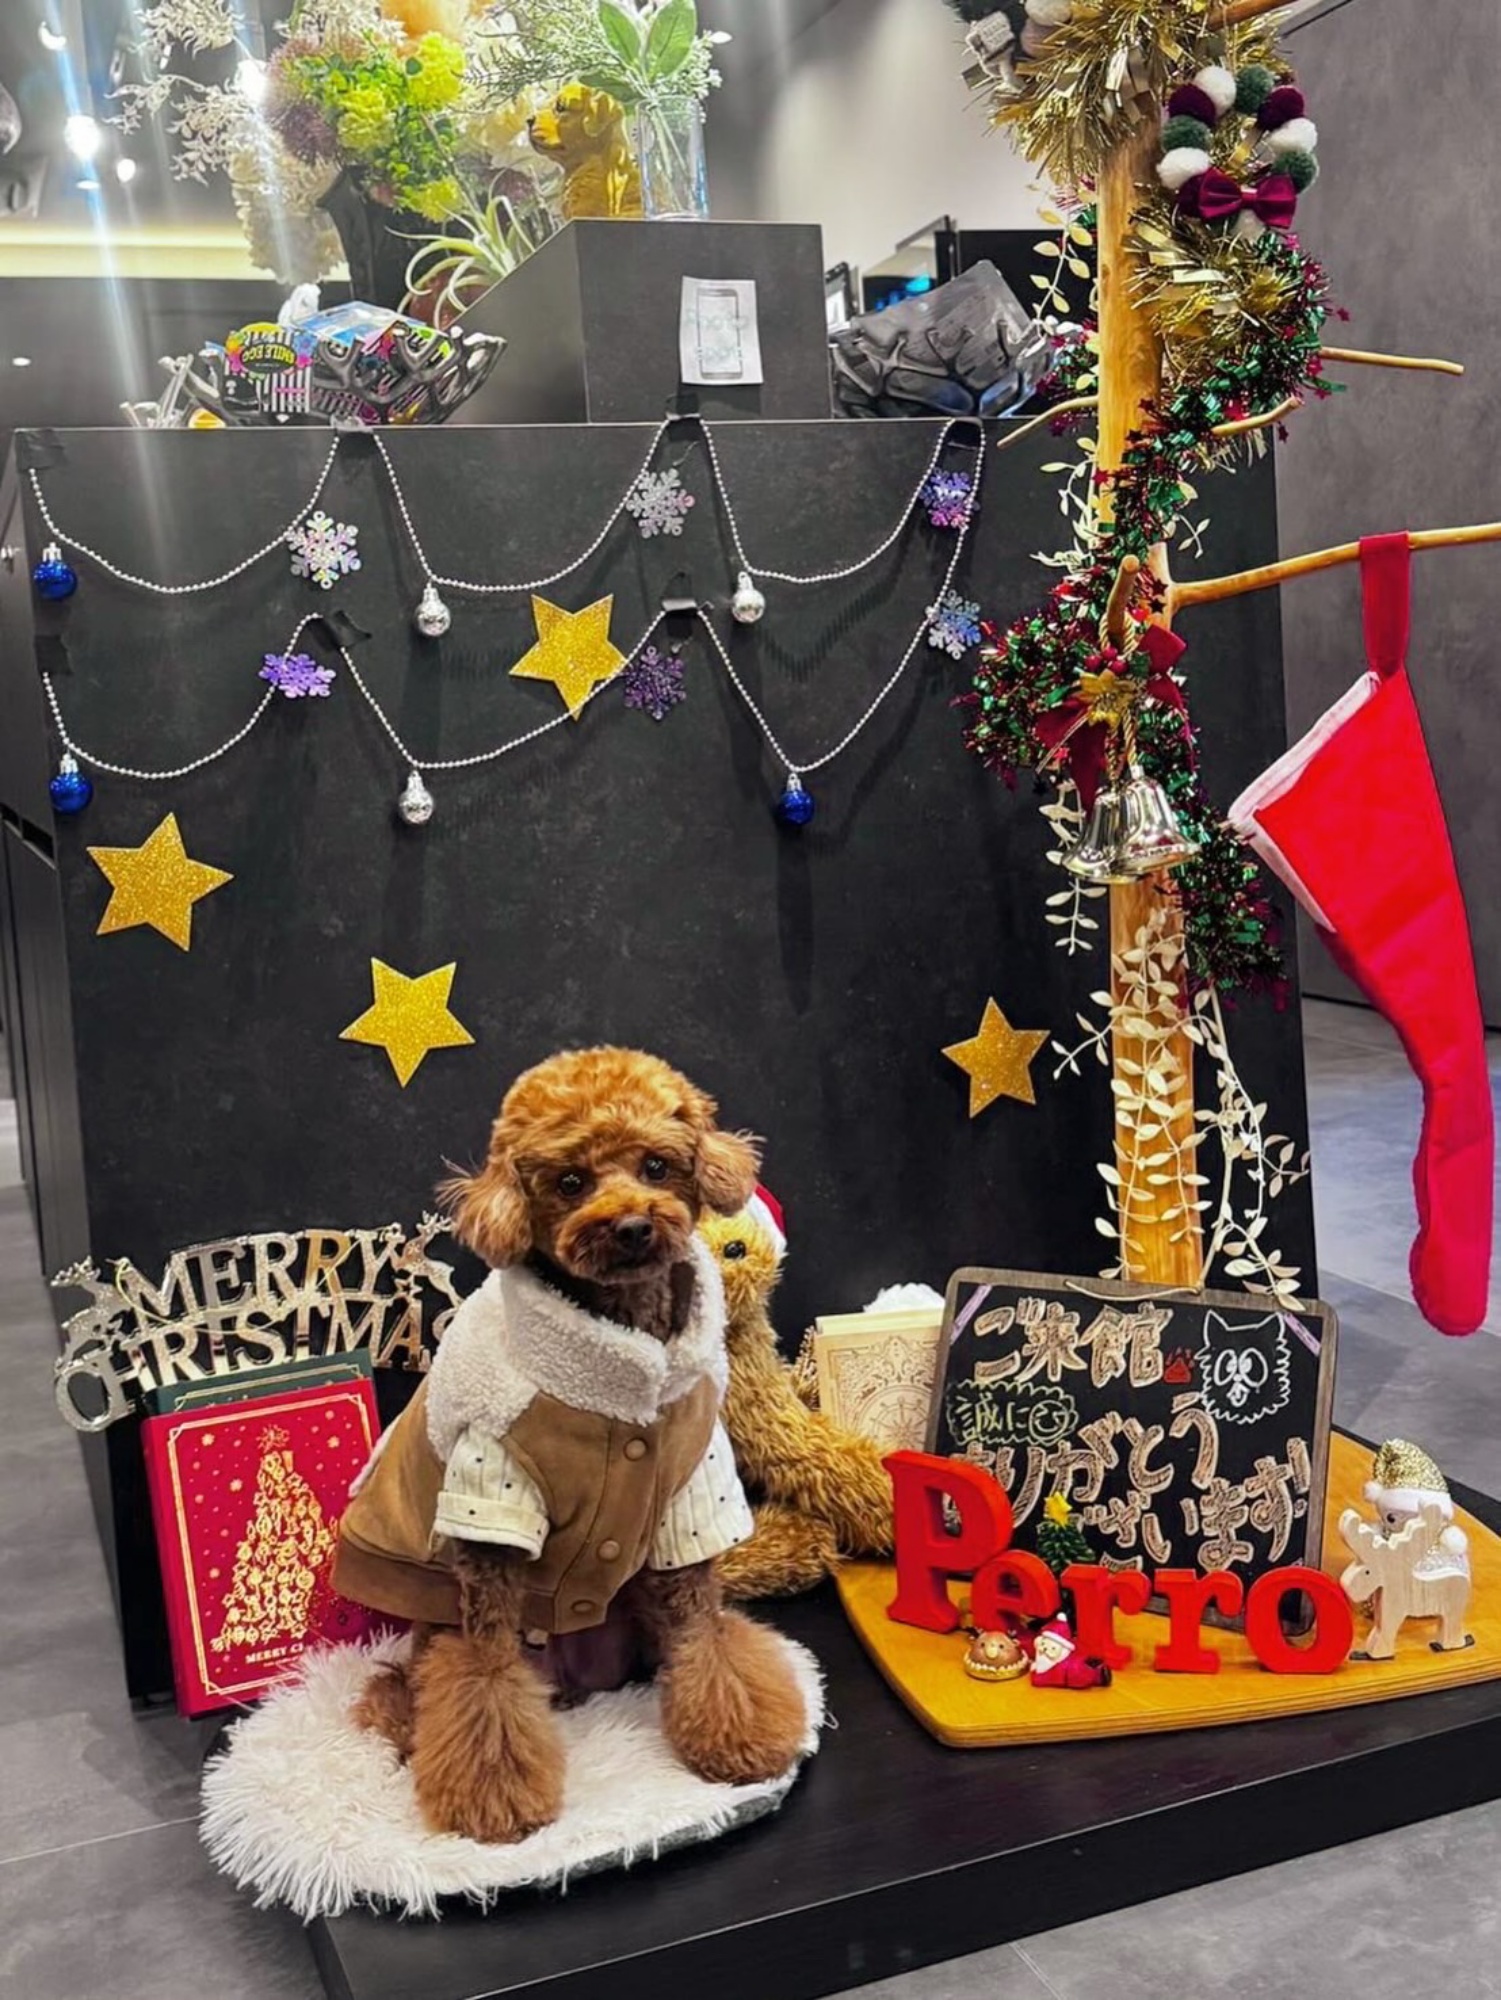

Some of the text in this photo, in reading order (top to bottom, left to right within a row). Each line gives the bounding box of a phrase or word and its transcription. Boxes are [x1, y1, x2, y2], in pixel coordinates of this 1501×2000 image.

[118, 1229, 405, 1324] MERRY
[972, 1295, 1174, 1389] ご来館
[956, 1392, 1030, 1441] 誠に
[880, 1448, 1353, 1676] Perro
